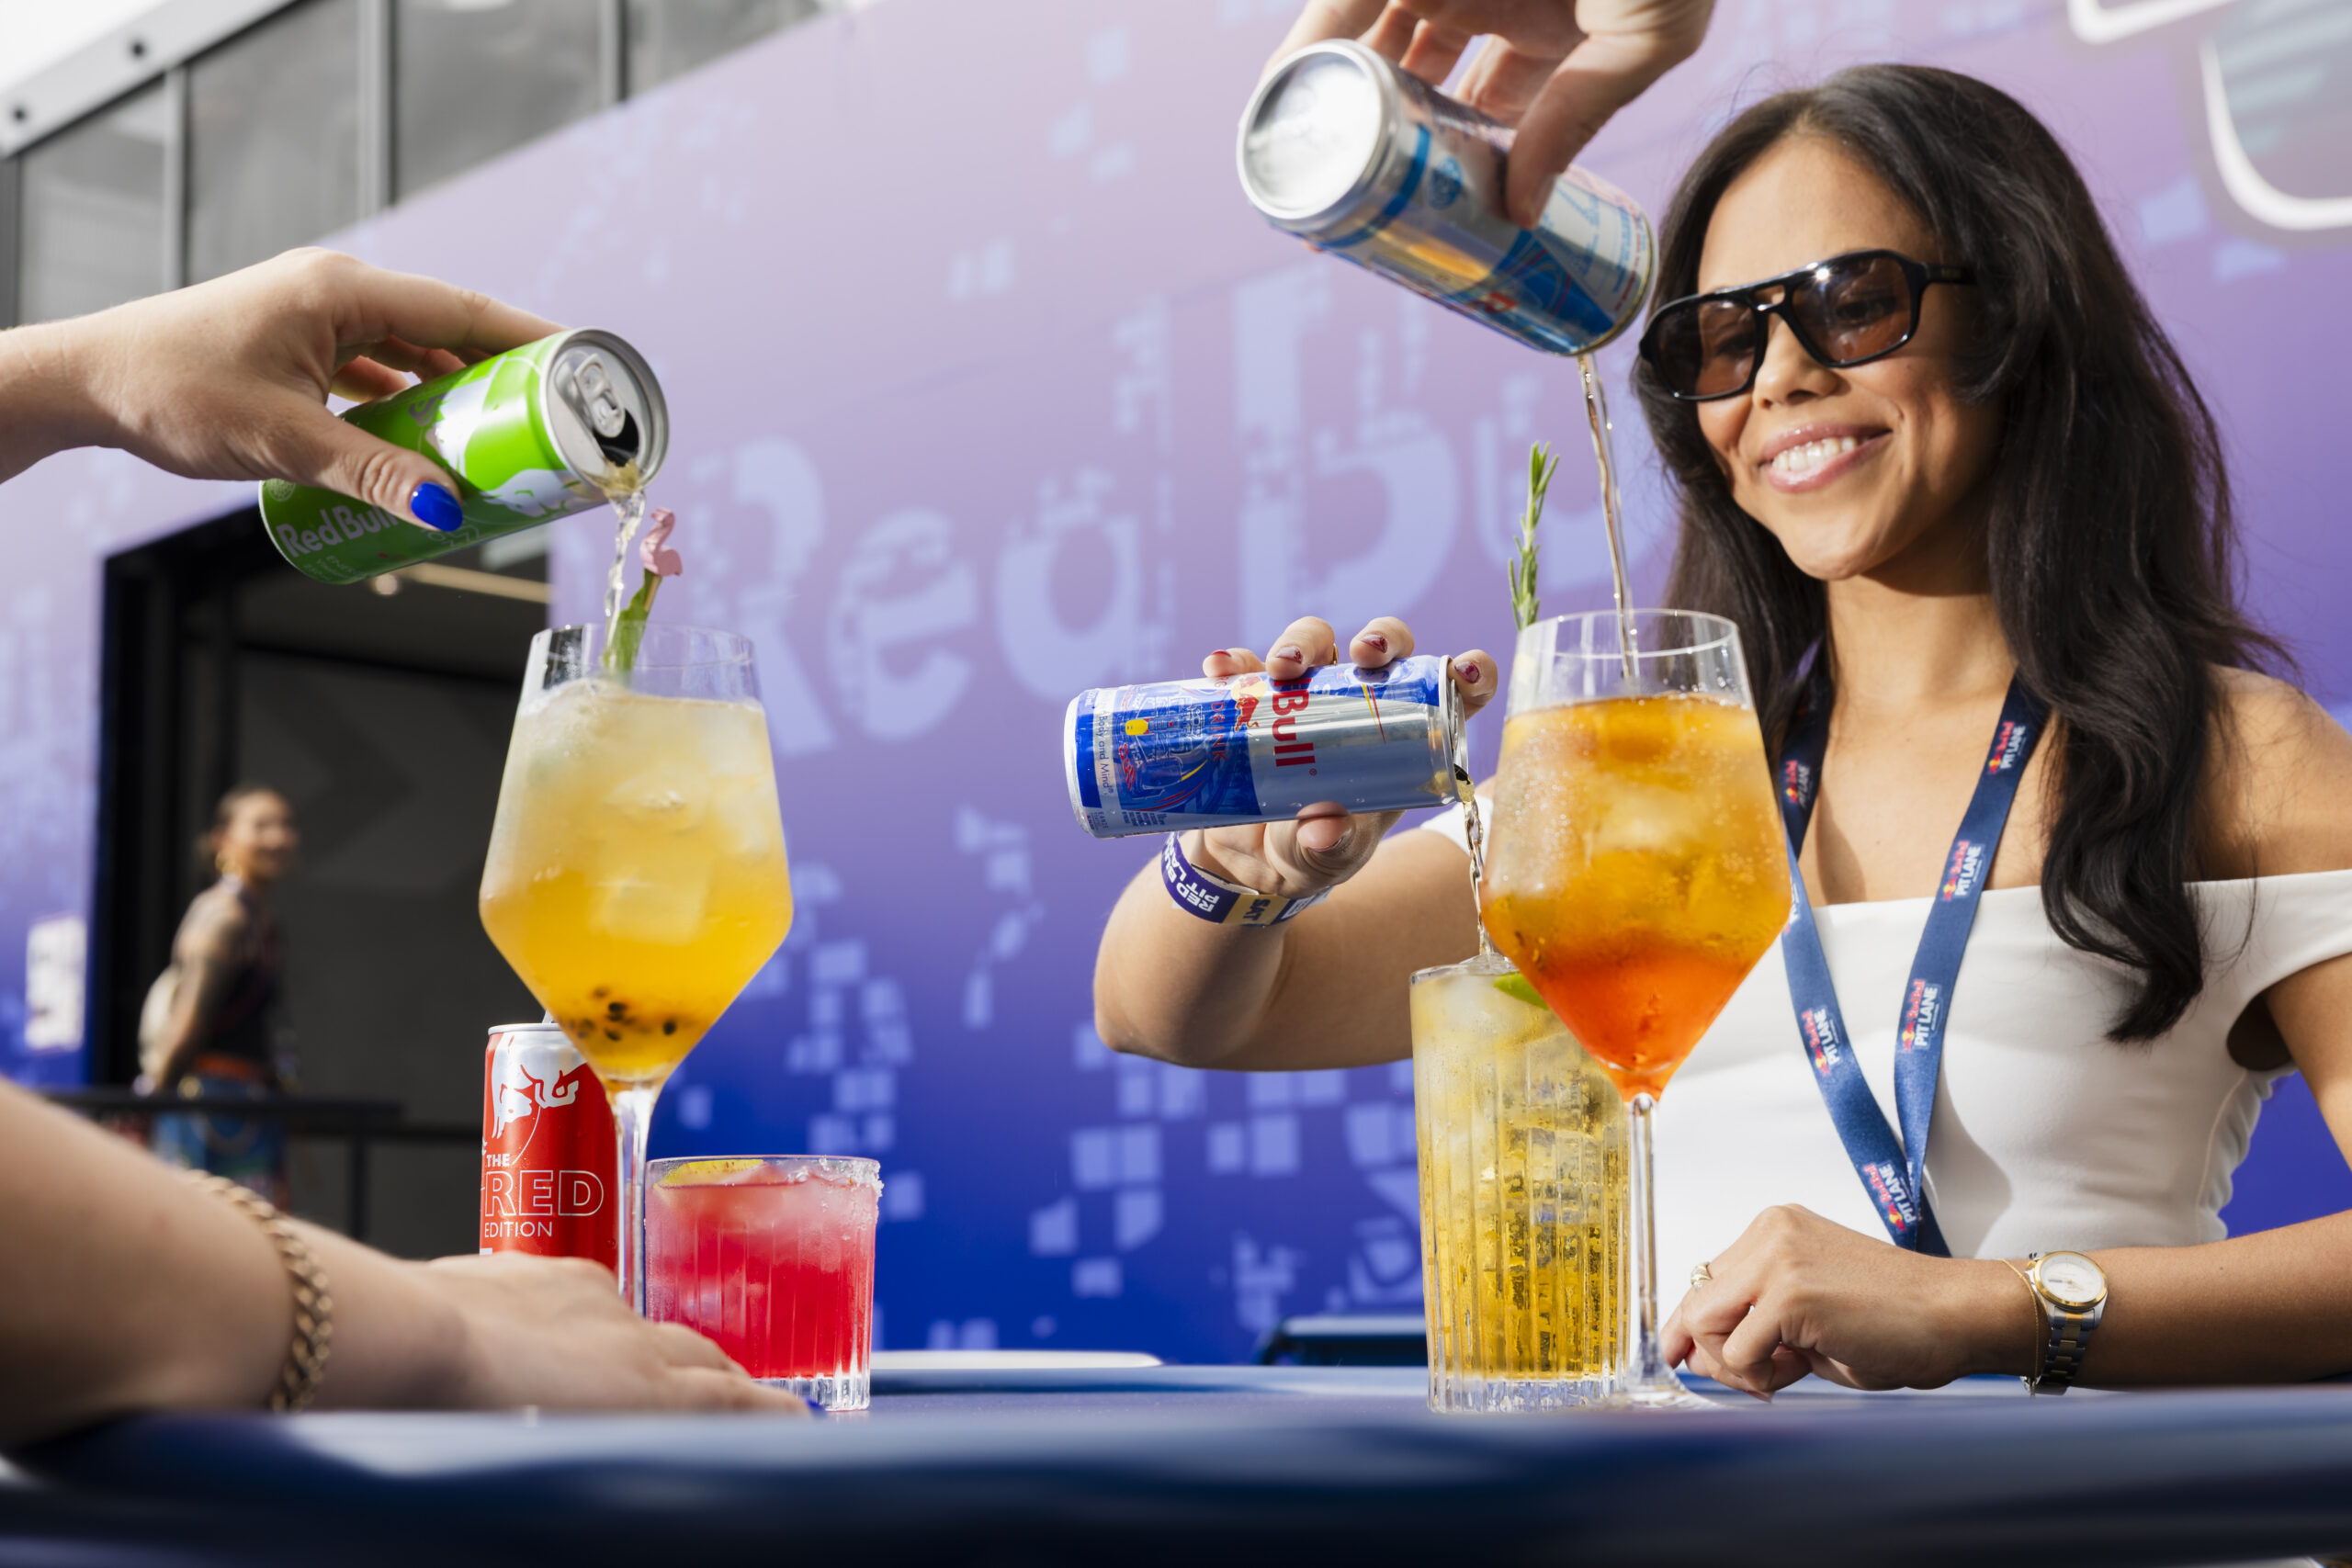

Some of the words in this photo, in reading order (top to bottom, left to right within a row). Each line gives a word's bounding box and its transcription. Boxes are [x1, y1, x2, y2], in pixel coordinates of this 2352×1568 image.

[277, 509, 344, 558] Red
[1096, 715, 1109, 739] Body
[1211, 702, 1227, 761] DRINK
[1099, 740, 1109, 761] and
[1176, 882, 1215, 912] RED
[1186, 882, 1220, 905] PIT
[1917, 987, 1939, 1023] LANE
[1814, 1009, 1833, 1045] LANE
[1914, 1024, 1930, 1046] PIT
[1823, 1045, 1840, 1066] PIT
[486, 1154, 510, 1168] THE
[485, 1170, 604, 1217] RED
[1879, 1164, 1906, 1202] LANE
[1897, 1201, 1917, 1224] PIT
[484, 1221, 552, 1238] EDITION
